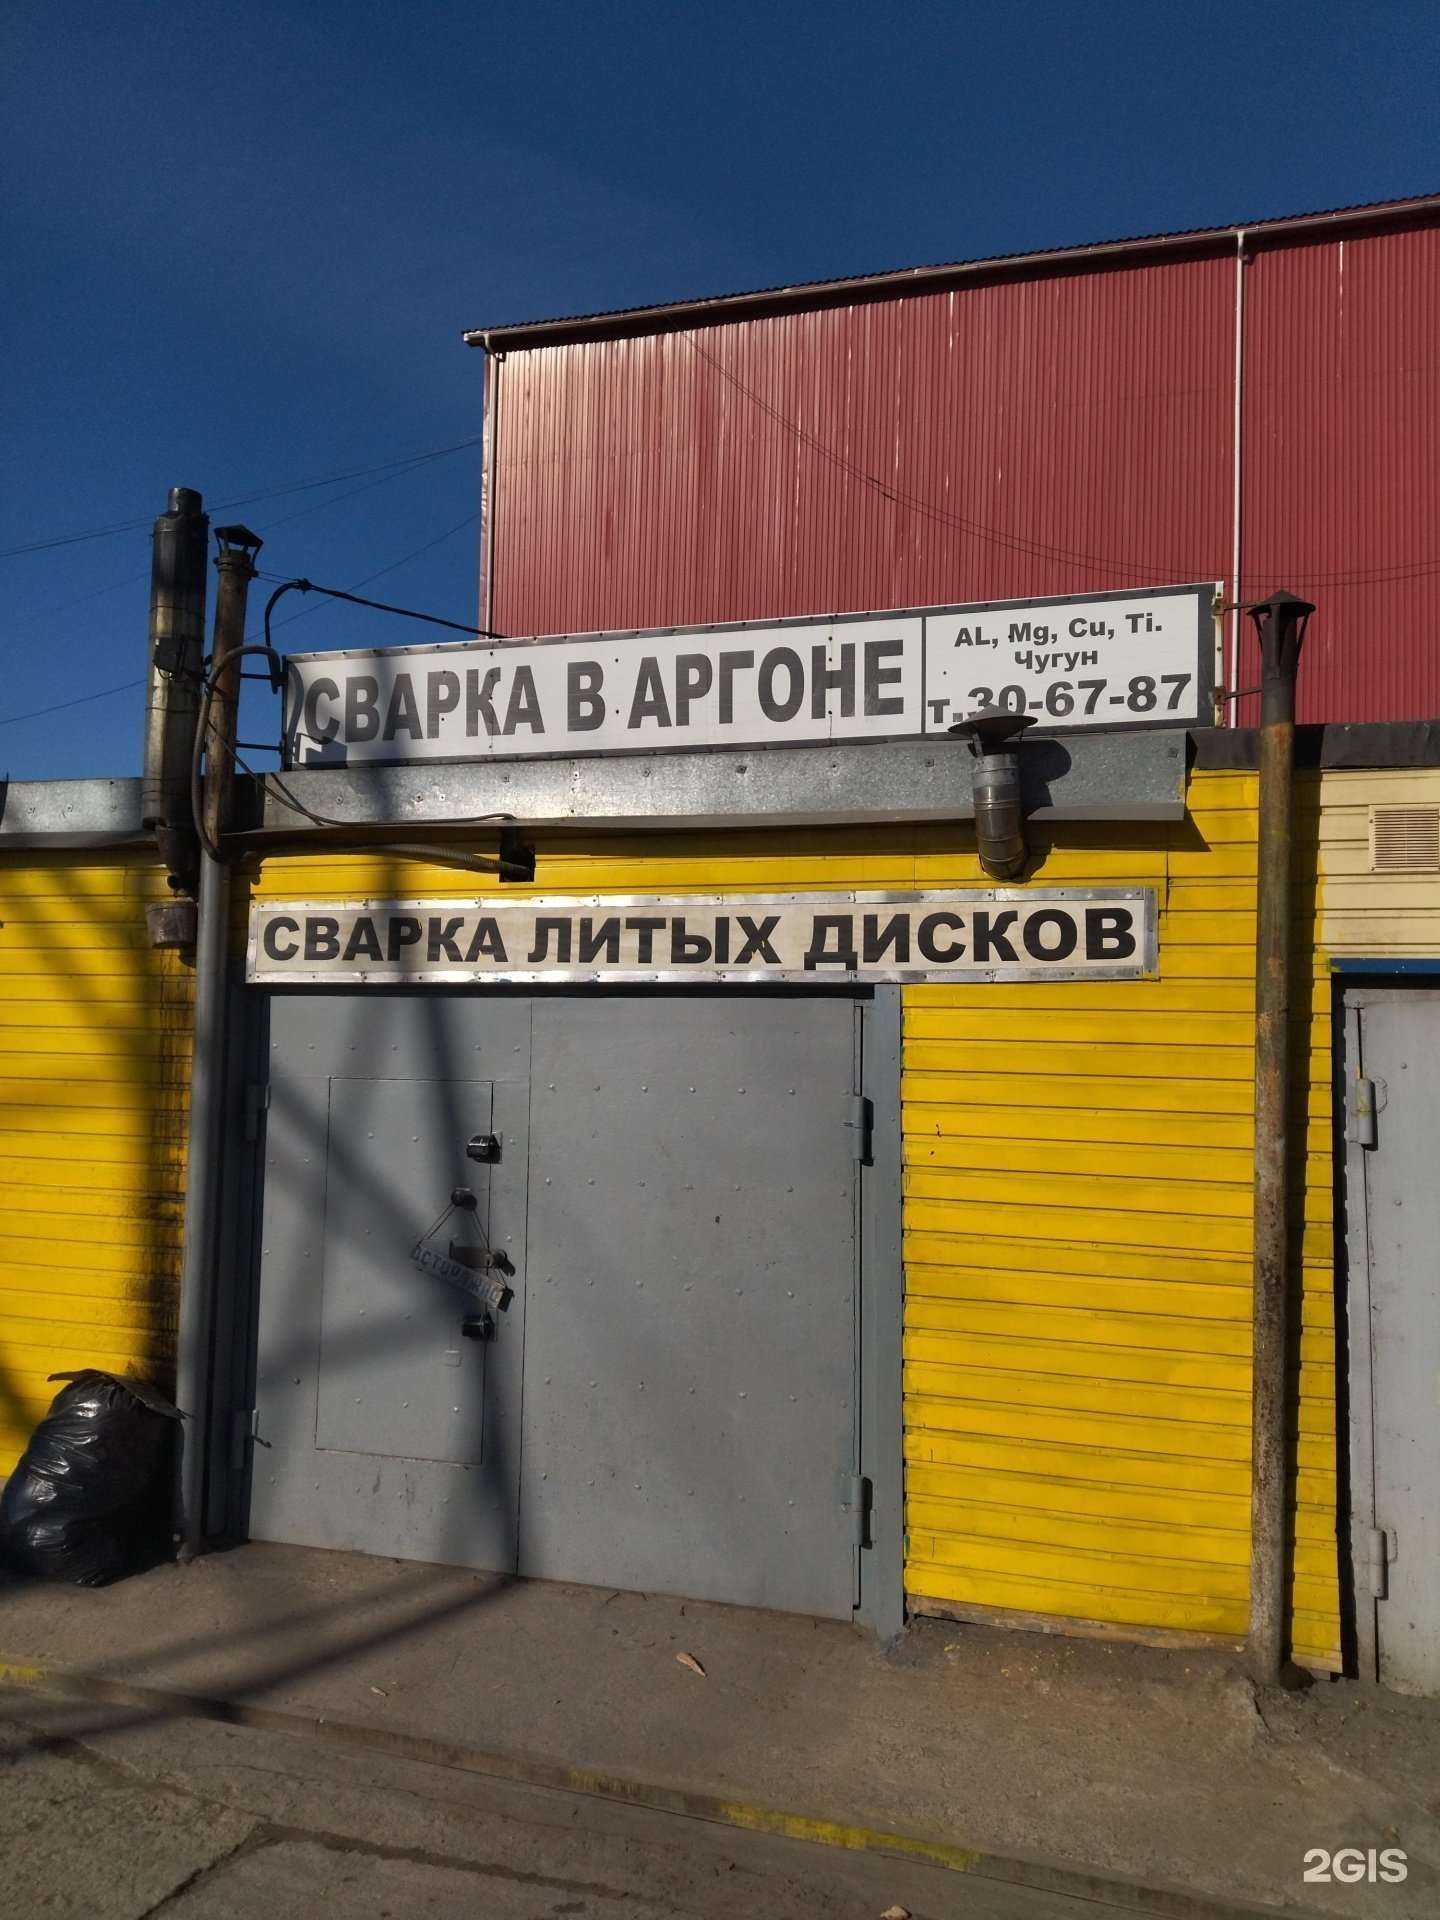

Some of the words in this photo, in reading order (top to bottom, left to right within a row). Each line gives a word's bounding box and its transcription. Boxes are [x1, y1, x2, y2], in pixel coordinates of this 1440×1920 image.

[1008, 621, 1058, 645] Mg,
[1068, 617, 1115, 640] Cu,
[1125, 612, 1163, 634] Ti.
[1014, 648, 1099, 674] Чугун
[304, 664, 545, 745] СВАРКА
[566, 660, 606, 732] В
[627, 639, 905, 730] АРГОНЕ
[263, 916, 509, 963] СВАРКА
[527, 916, 783, 964] ЛИТЫХ
[803, 907, 1137, 971] ДИСКОВ
